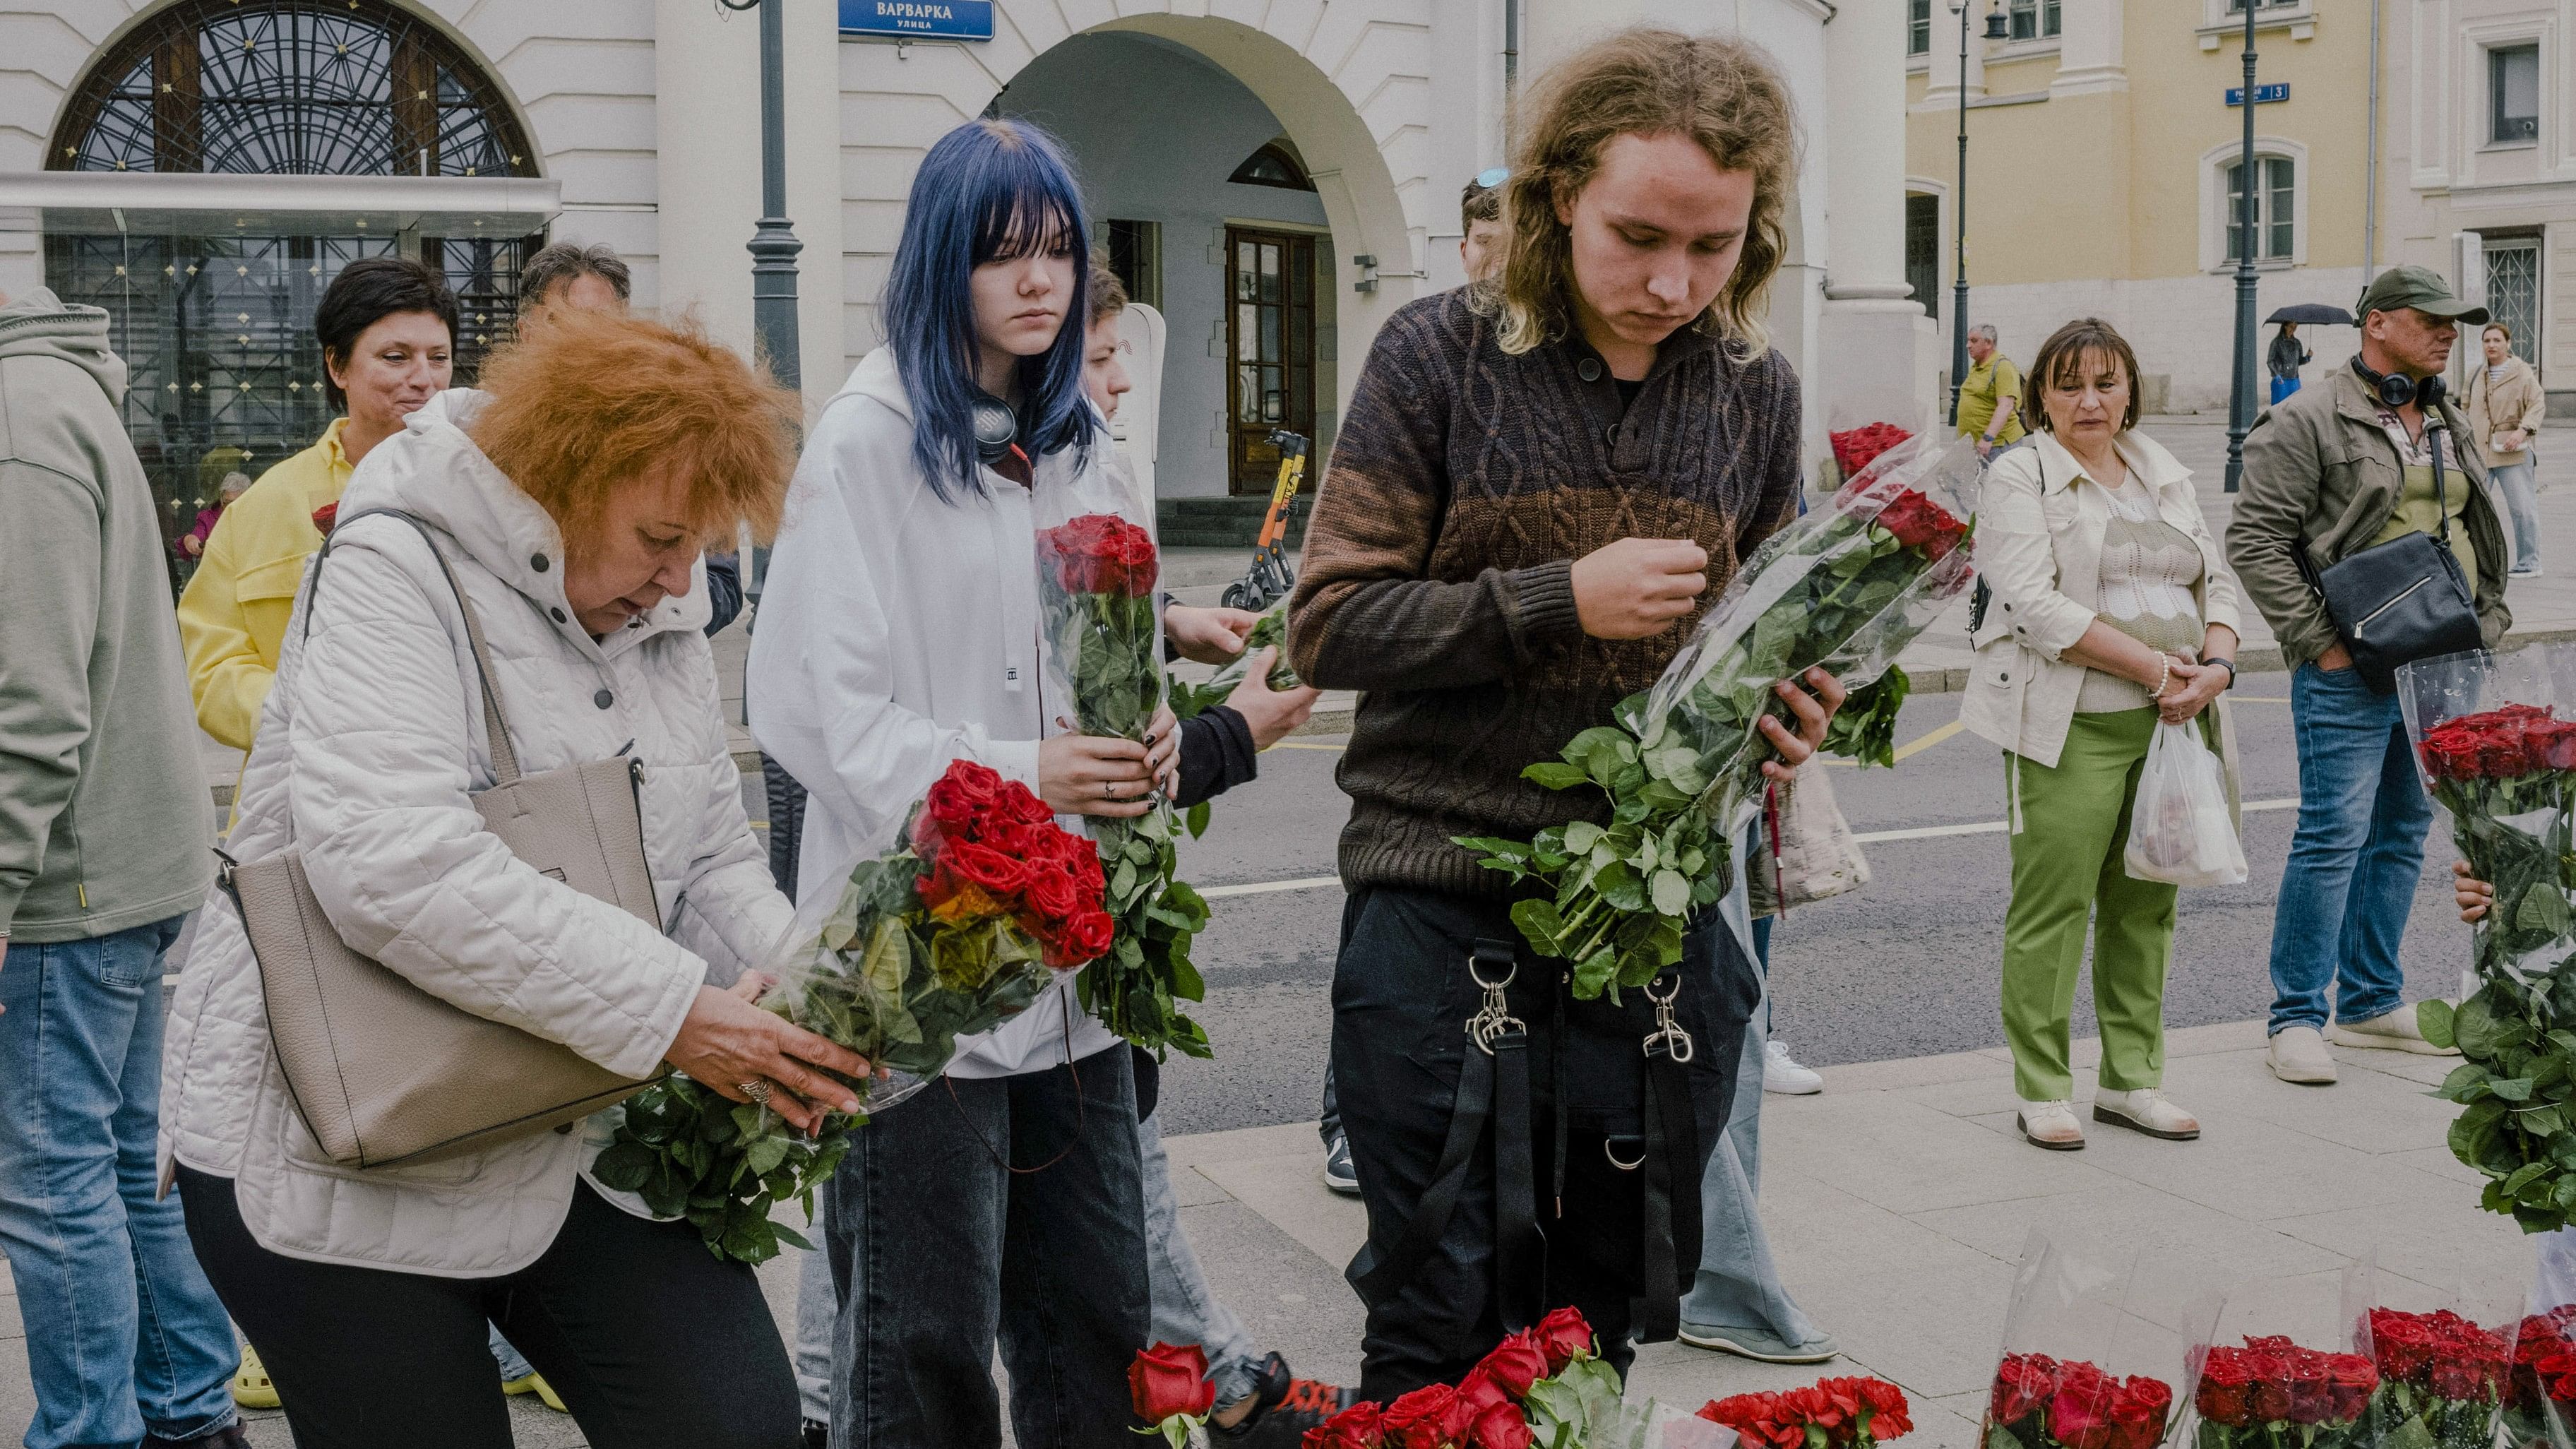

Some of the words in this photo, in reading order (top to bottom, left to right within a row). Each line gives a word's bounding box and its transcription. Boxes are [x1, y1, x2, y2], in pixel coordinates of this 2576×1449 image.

[877, 2, 953, 19] ВАРВАРКА
[898, 20, 931, 29] УЛИЦА
[2275, 85, 2282, 97] 3
[980, 407, 1005, 431] JBL
